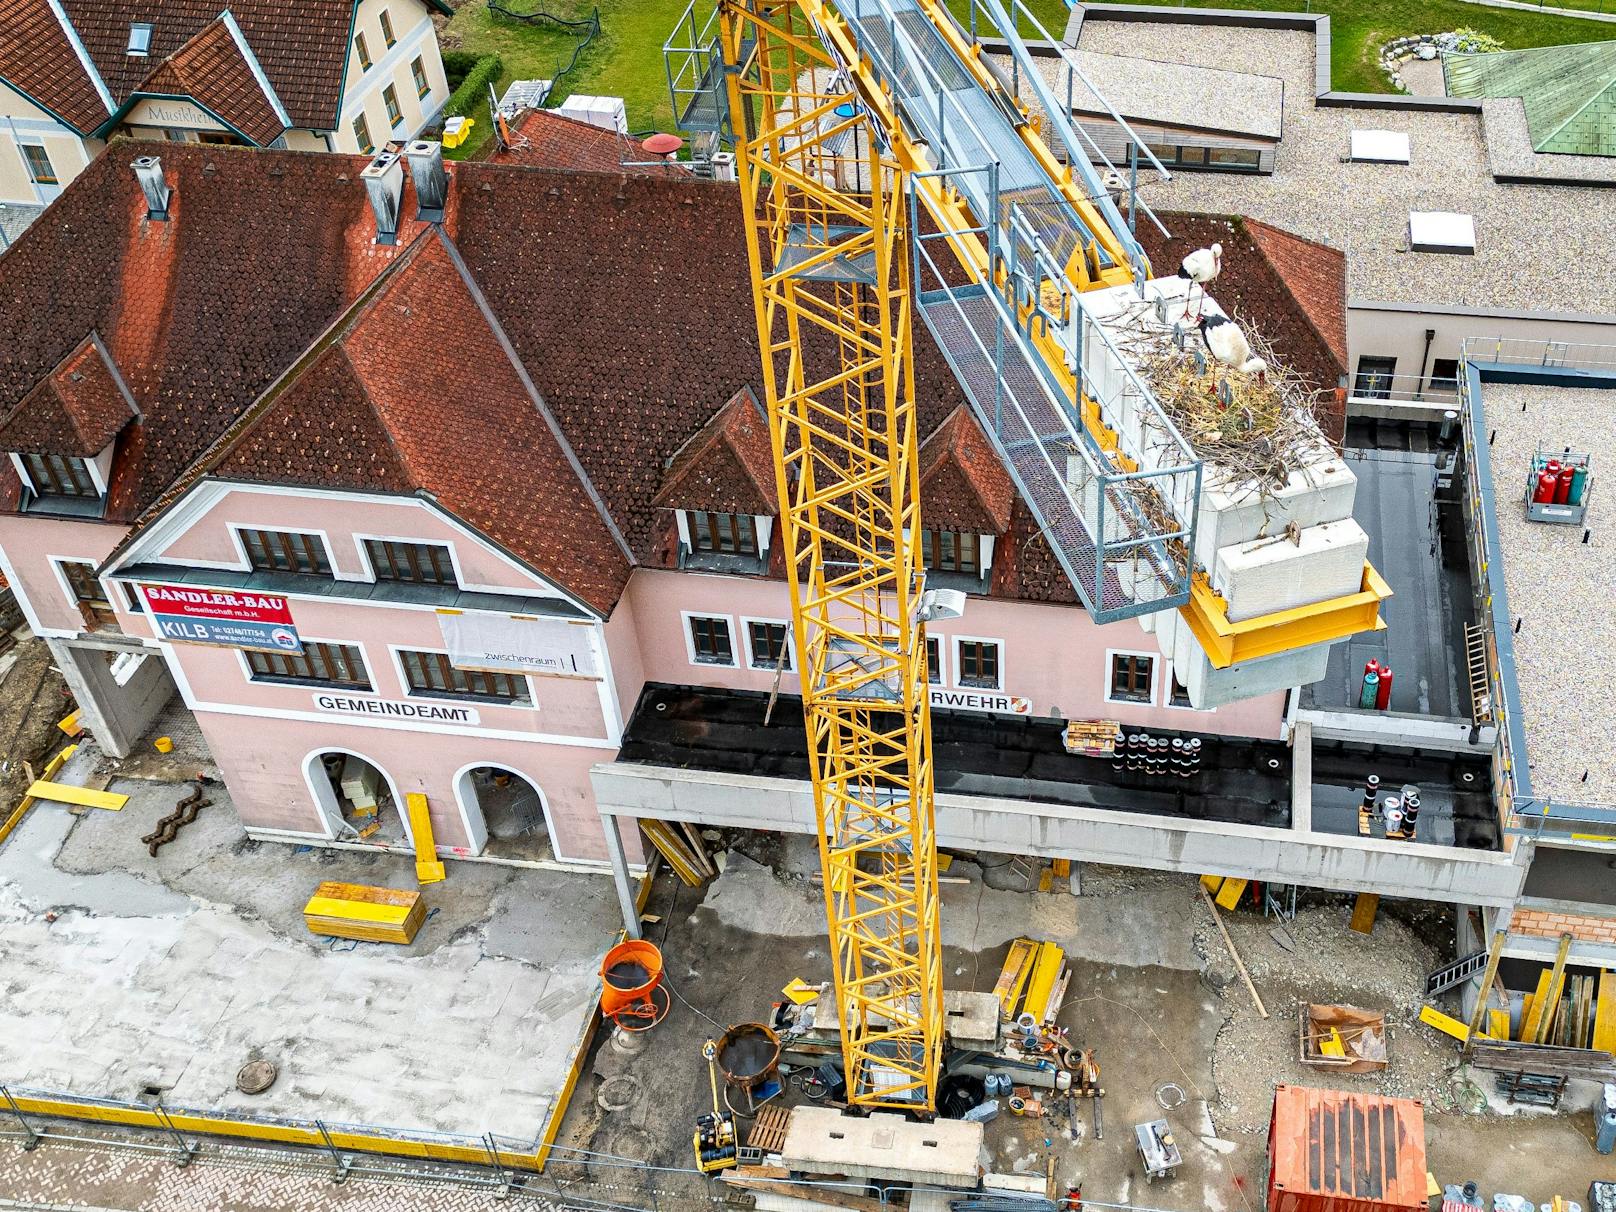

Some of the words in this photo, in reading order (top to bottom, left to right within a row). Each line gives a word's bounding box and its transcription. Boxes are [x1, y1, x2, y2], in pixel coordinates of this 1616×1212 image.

[146, 587, 283, 610] SANDLER-BAU
[184, 605, 233, 616] Gesellschaft
[162, 621, 209, 639] KILB
[484, 652, 556, 666] zwischenraum
[319, 696, 469, 722] GEMEINDEAMT
[931, 692, 1008, 710] RWEHR
